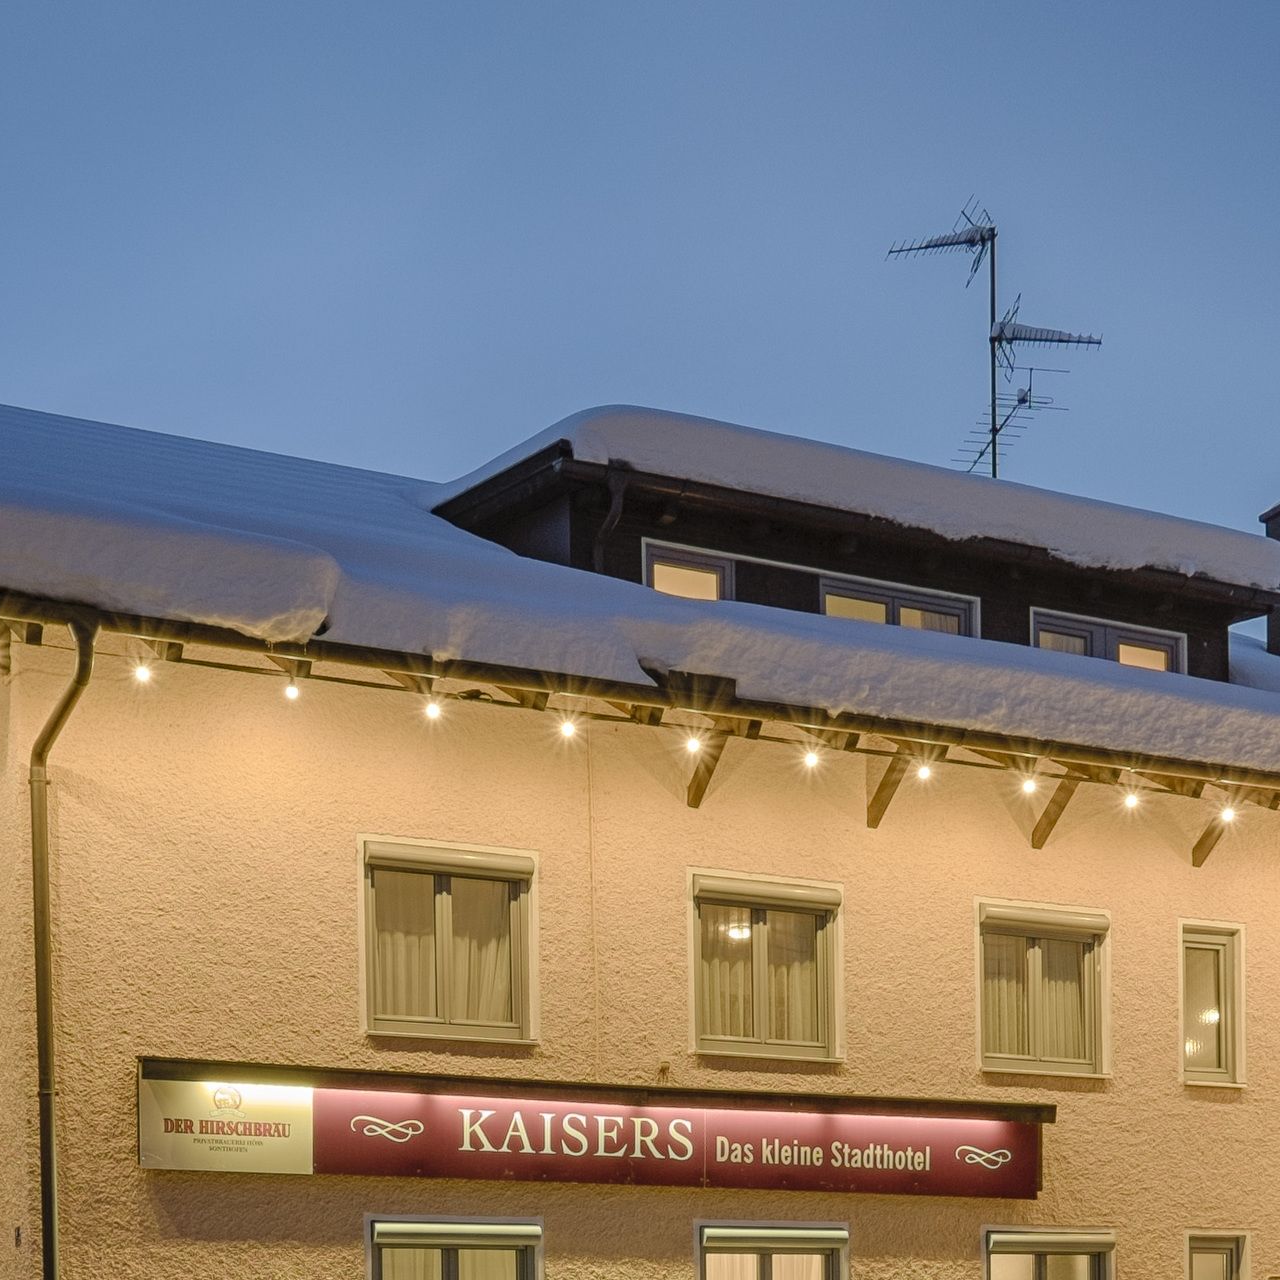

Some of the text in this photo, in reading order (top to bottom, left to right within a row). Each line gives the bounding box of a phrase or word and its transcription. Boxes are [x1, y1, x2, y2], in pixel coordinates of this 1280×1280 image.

[163, 1118, 291, 1138] DER HIRSCHBRÄU
[458, 1108, 930, 1171] KAISERS Das kleine Stadthotel
